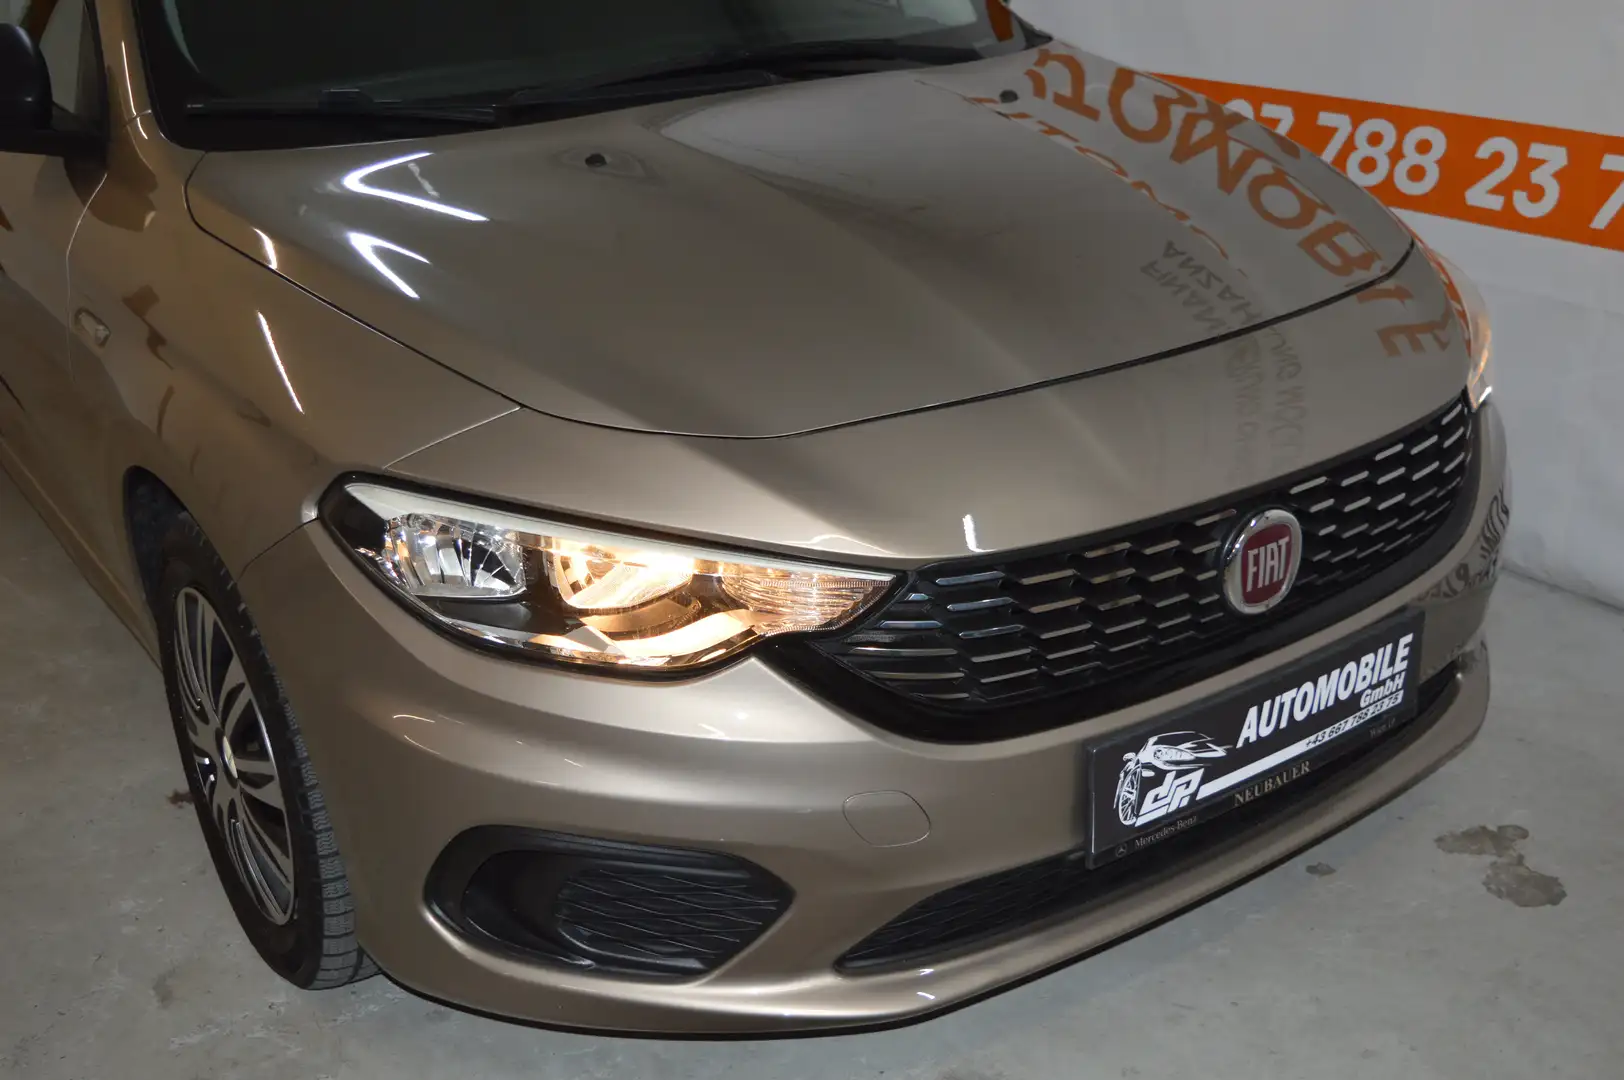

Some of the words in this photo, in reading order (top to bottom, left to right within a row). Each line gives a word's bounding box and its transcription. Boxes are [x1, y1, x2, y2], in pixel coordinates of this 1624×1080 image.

[1316, 111, 1447, 196] 788
[1465, 137, 1568, 218] 23
[1246, 535, 1291, 593] FIAT
[1235, 632, 1414, 749] AUTOMOBILE
[1360, 671, 1406, 708] GmbH
[1234, 761, 1312, 807] NEUBAUER
[1133, 815, 1198, 850] Mercedes-Benz
